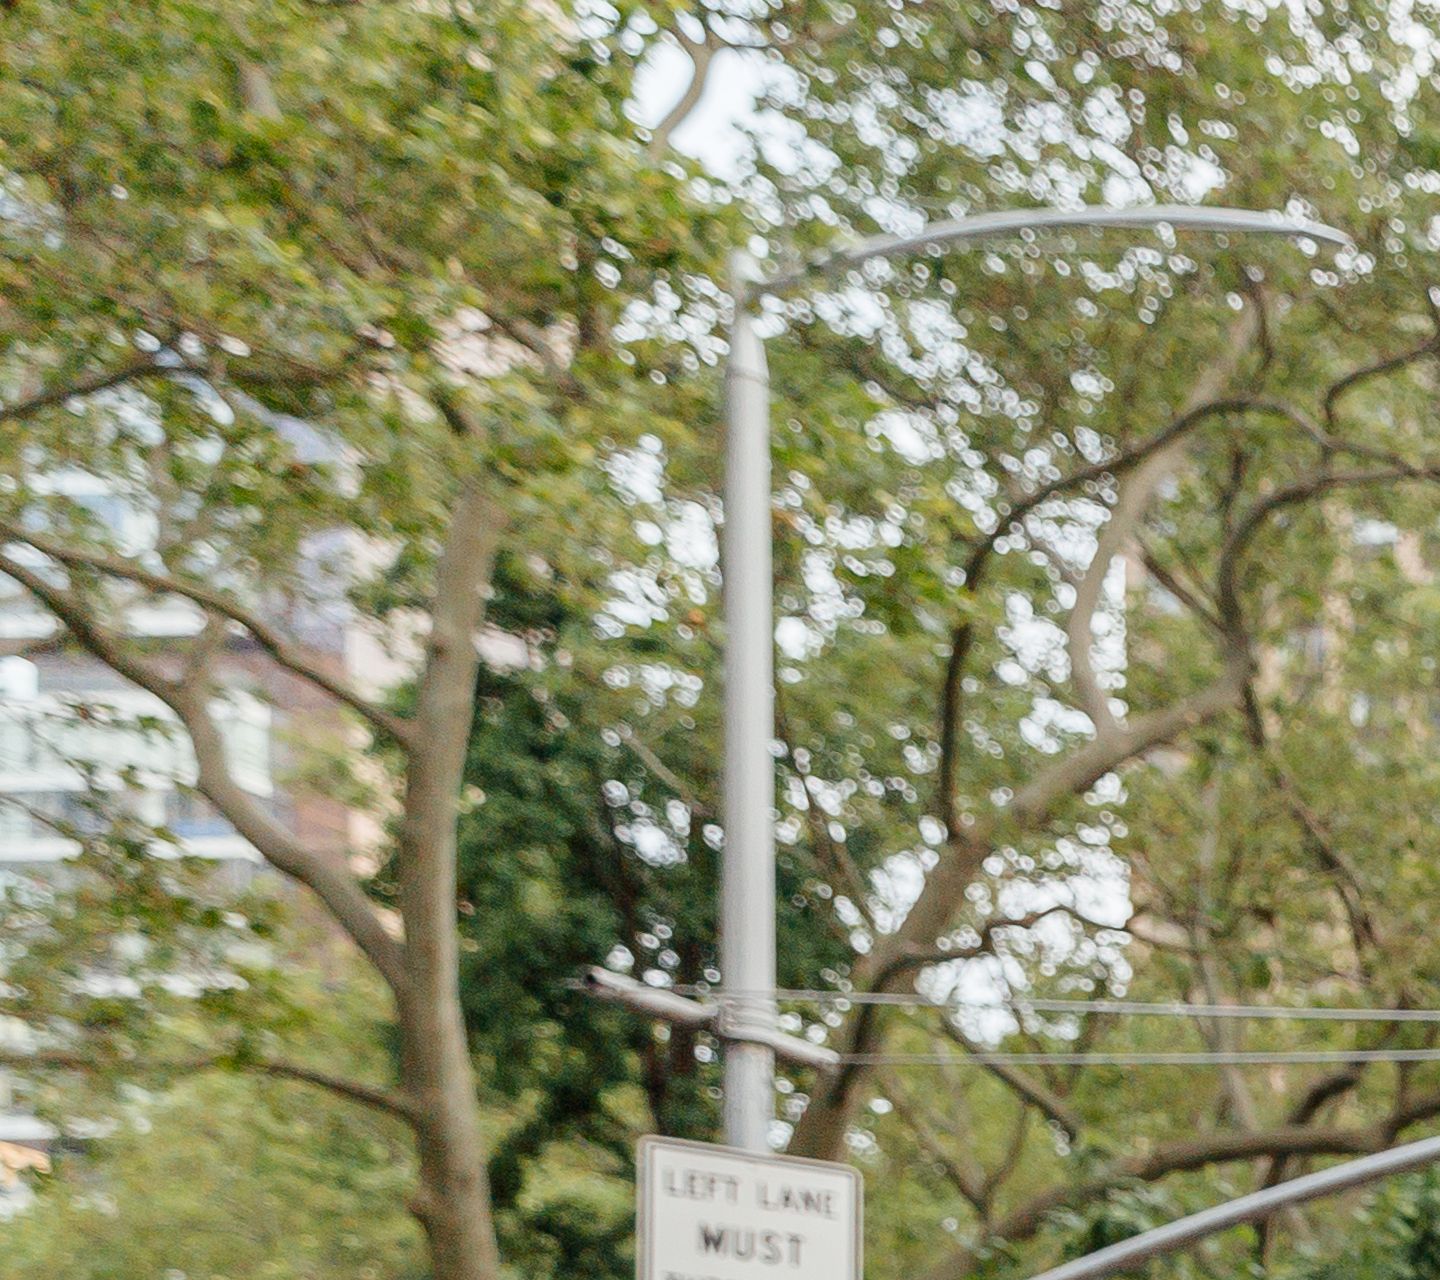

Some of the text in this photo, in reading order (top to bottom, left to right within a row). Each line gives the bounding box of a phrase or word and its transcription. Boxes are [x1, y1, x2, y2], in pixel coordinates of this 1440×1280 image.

[662, 1168, 839, 1220] LEFT LANE
[698, 1220, 804, 1269] MUST
